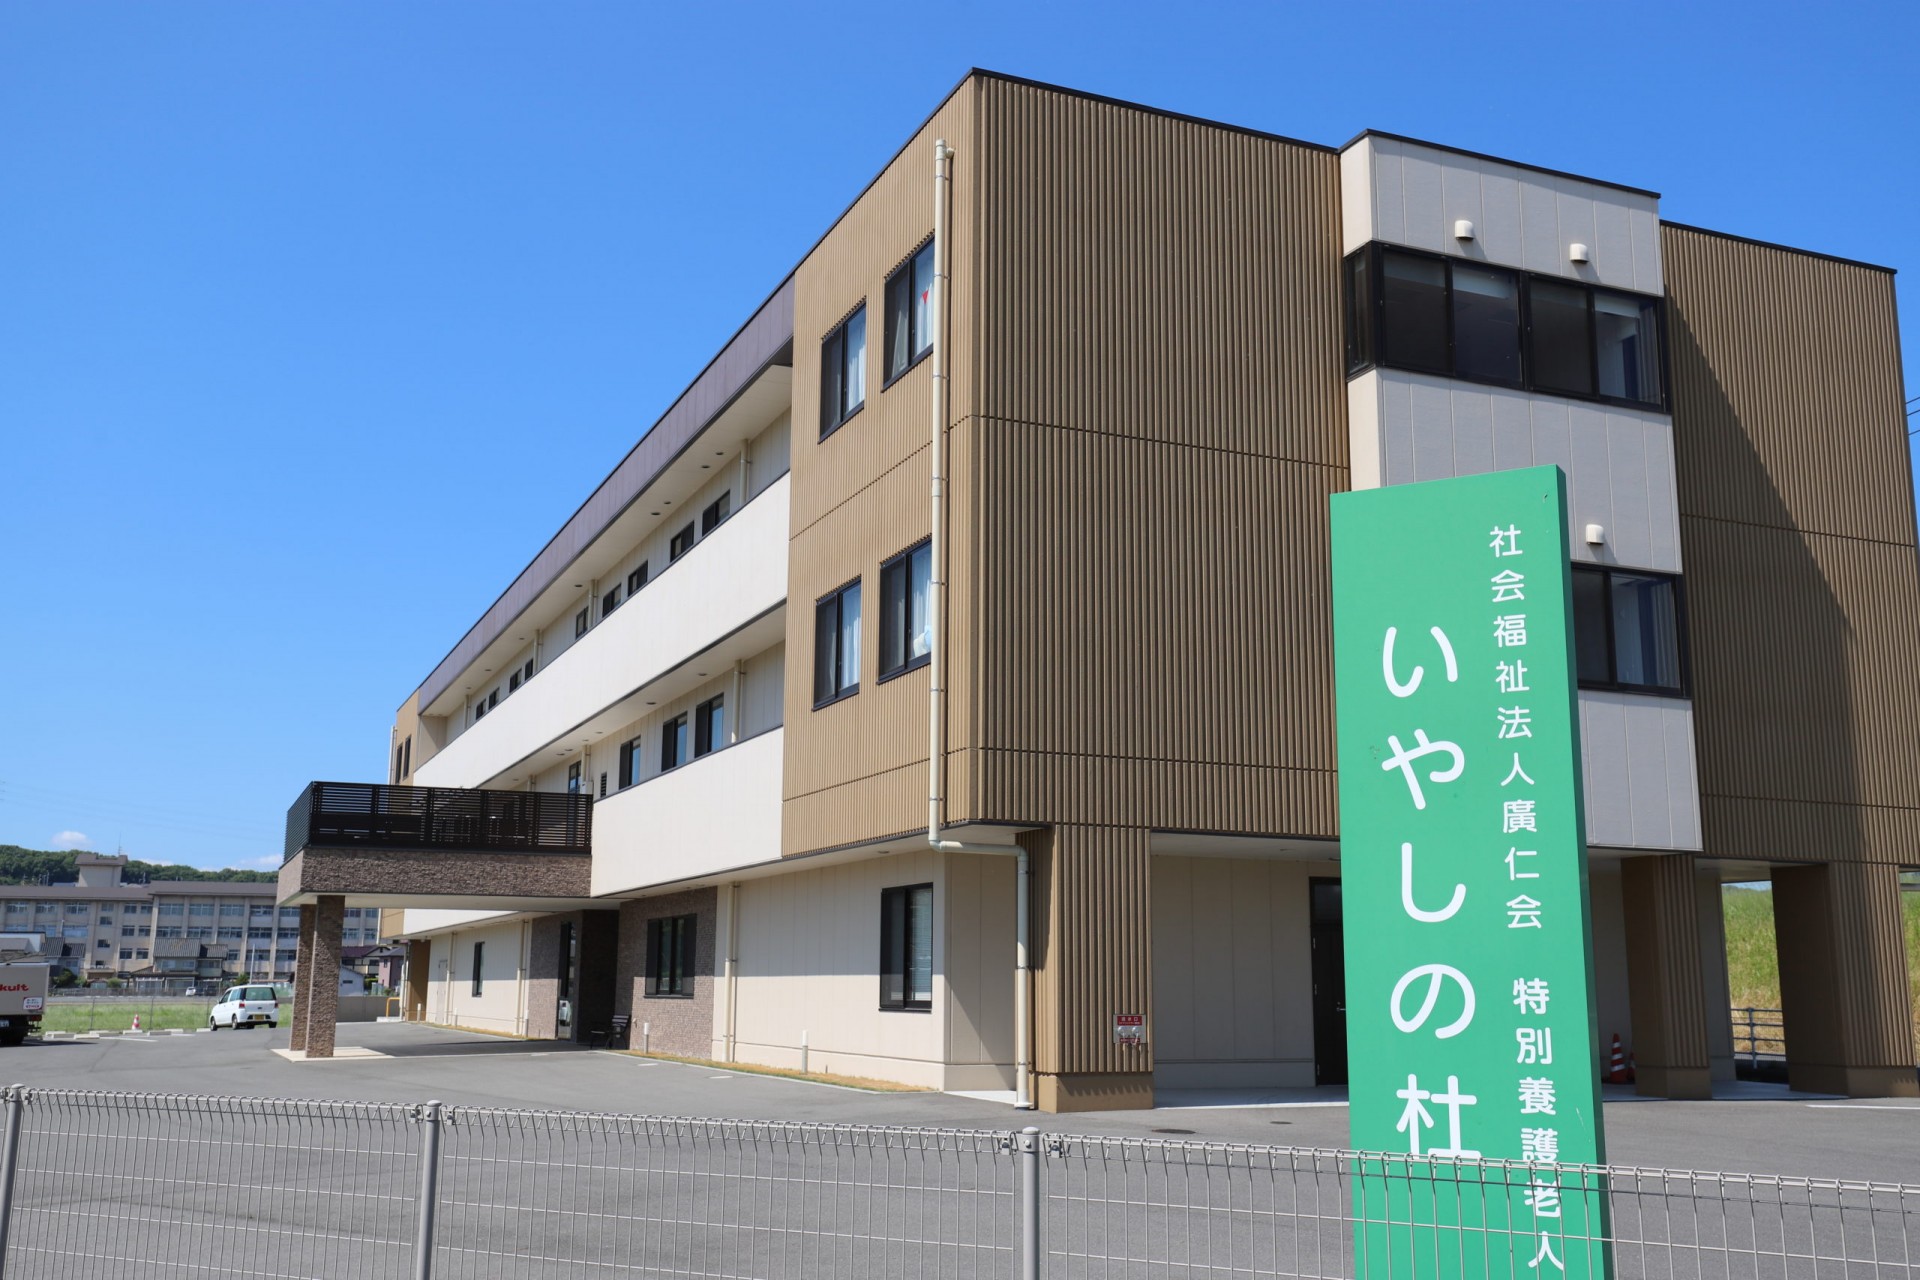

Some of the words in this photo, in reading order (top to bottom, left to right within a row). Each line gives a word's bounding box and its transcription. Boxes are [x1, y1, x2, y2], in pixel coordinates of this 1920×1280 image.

[1381, 625, 1481, 1161] いやしの杜
[1489, 523, 1541, 929] 社会福祉法人廣仁会
[1512, 977, 1565, 1271] 特別養護老人
